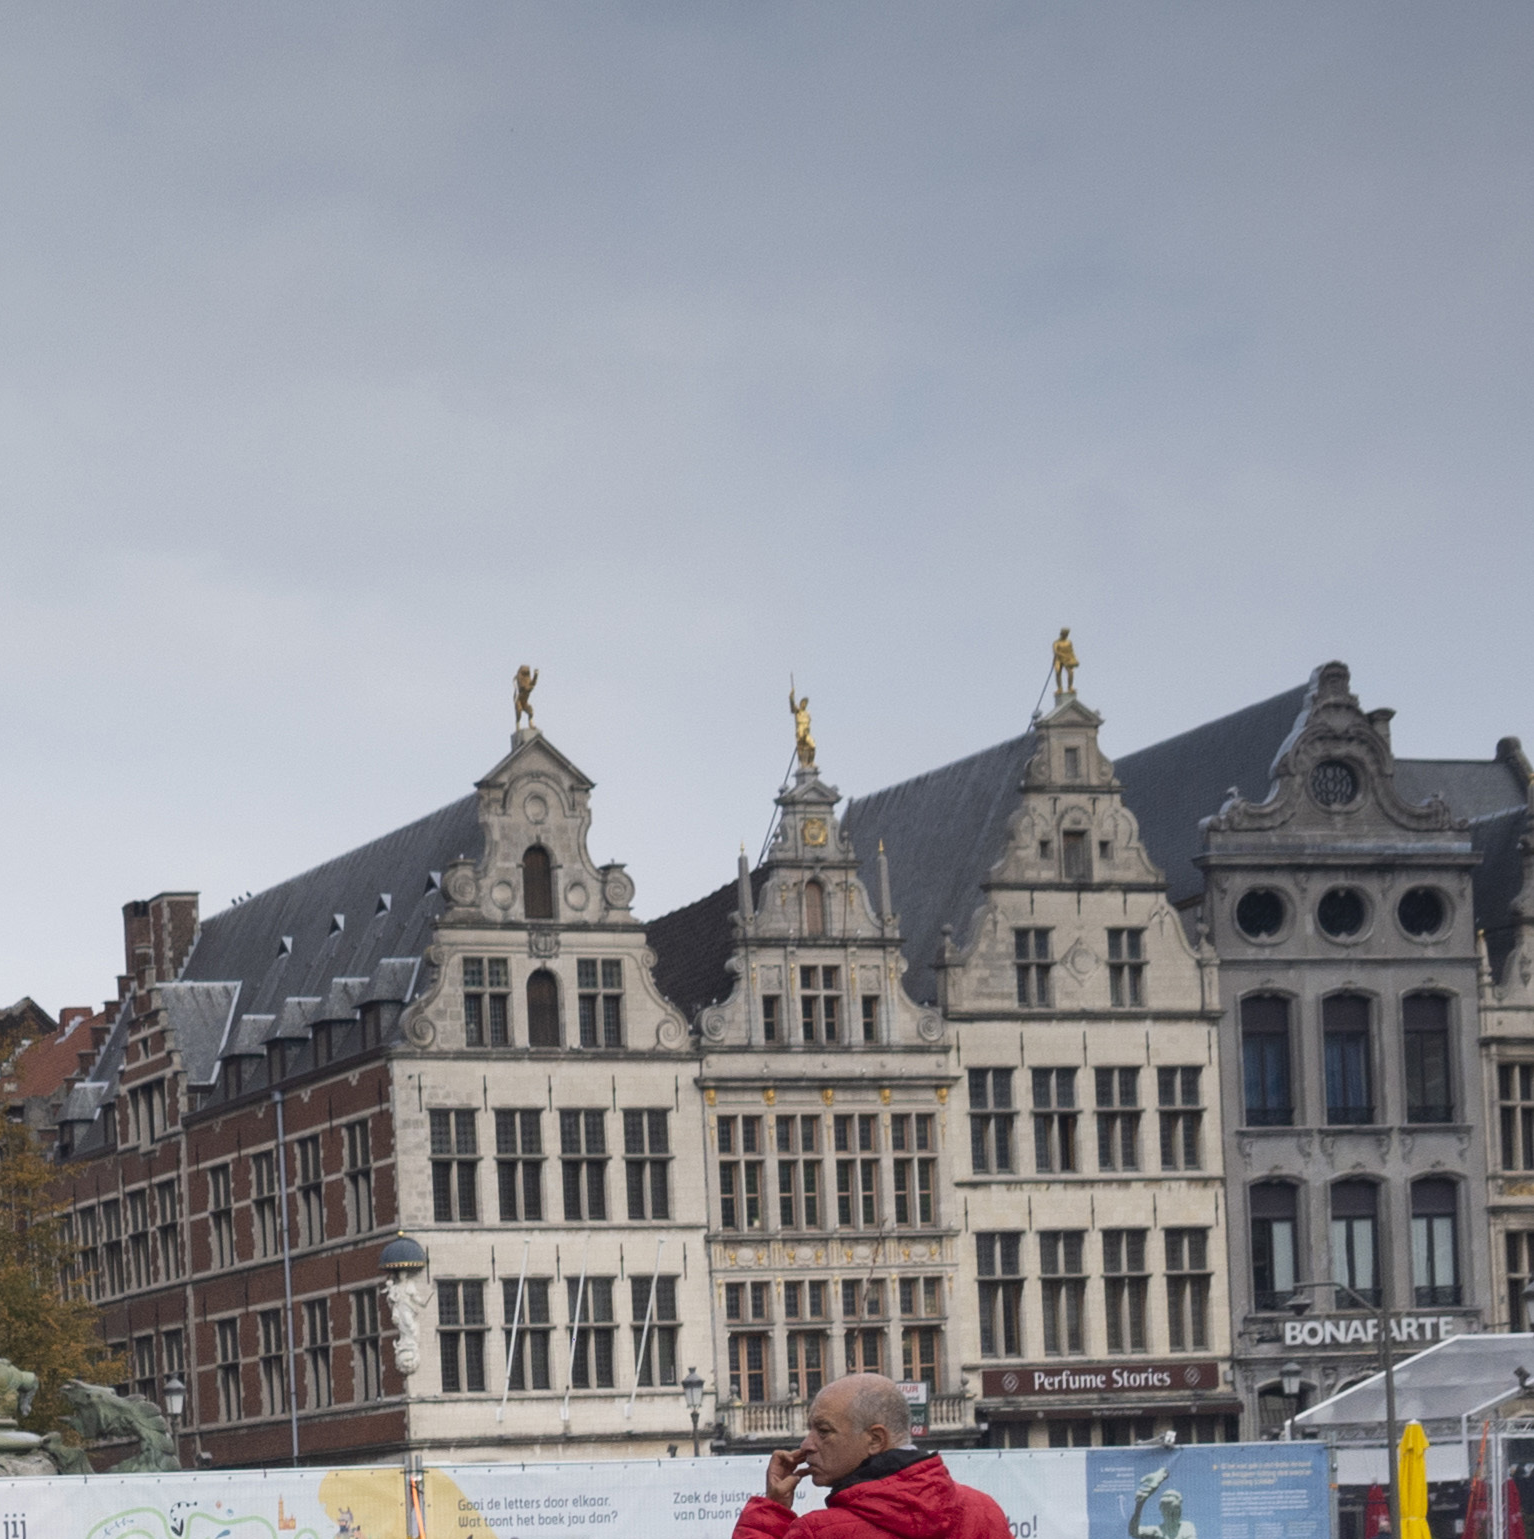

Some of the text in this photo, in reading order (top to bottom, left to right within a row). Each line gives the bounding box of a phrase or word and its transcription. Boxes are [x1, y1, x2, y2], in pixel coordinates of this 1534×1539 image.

[1284, 1316, 1454, 1346] BONAPARTE
[1034, 1368, 1171, 1390] Perfume Stories
[458, 1495, 611, 1511] Gooi de letters door elkaar.
[674, 1492, 701, 1504] Zoek
[704, 1491, 718, 1503] de
[458, 1510, 618, 1528] Wat toont het boek jou dan?
[674, 1510, 695, 1520] van
[698, 1508, 732, 1520] Druon
[1007, 1515, 1038, 1539] bo!
